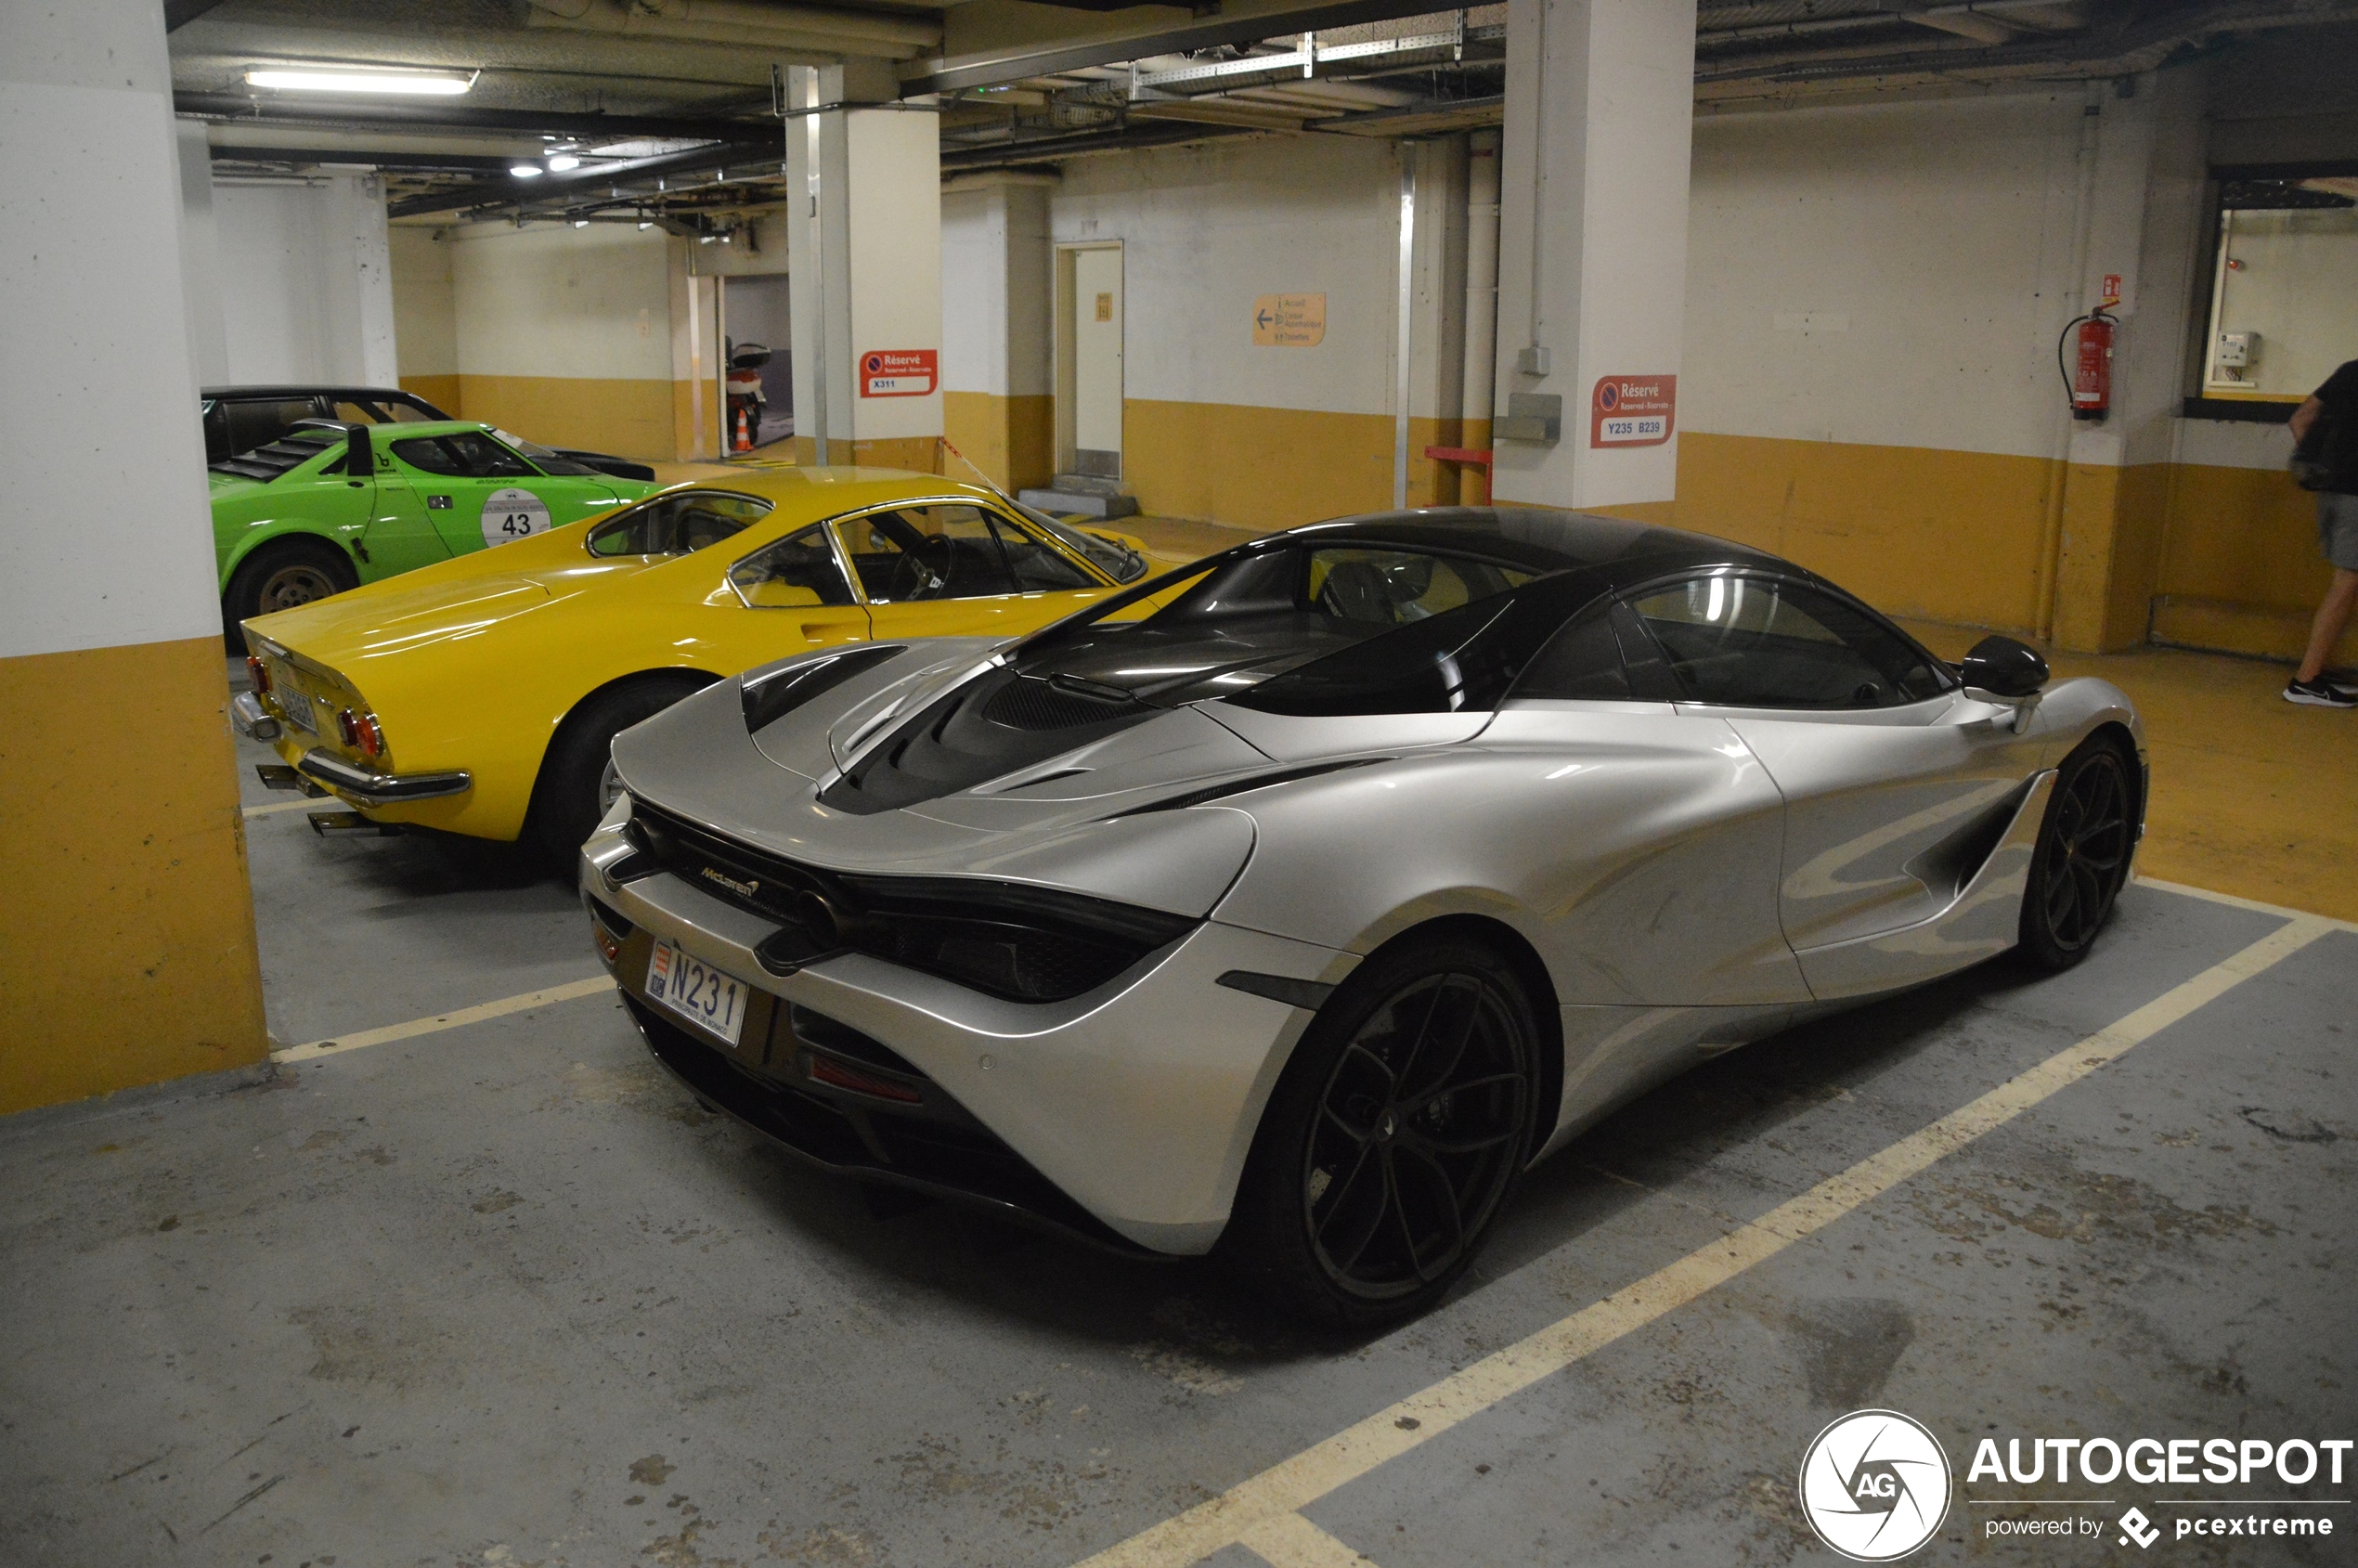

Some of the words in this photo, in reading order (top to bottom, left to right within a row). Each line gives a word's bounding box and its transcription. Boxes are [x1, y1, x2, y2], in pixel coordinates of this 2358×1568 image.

[885, 355, 921, 366] Réservé
[874, 380, 895, 389] X311
[1621, 382, 1659, 398] Réservé
[1620, 401, 1644, 410] Reserved
[1608, 422, 1633, 434] Y235
[1639, 421, 1660, 434] B239
[502, 513, 531, 536] 43
[701, 867, 753, 897] McLaren
[671, 953, 736, 1026] N231
[706, 1018, 728, 1035] MONACO
